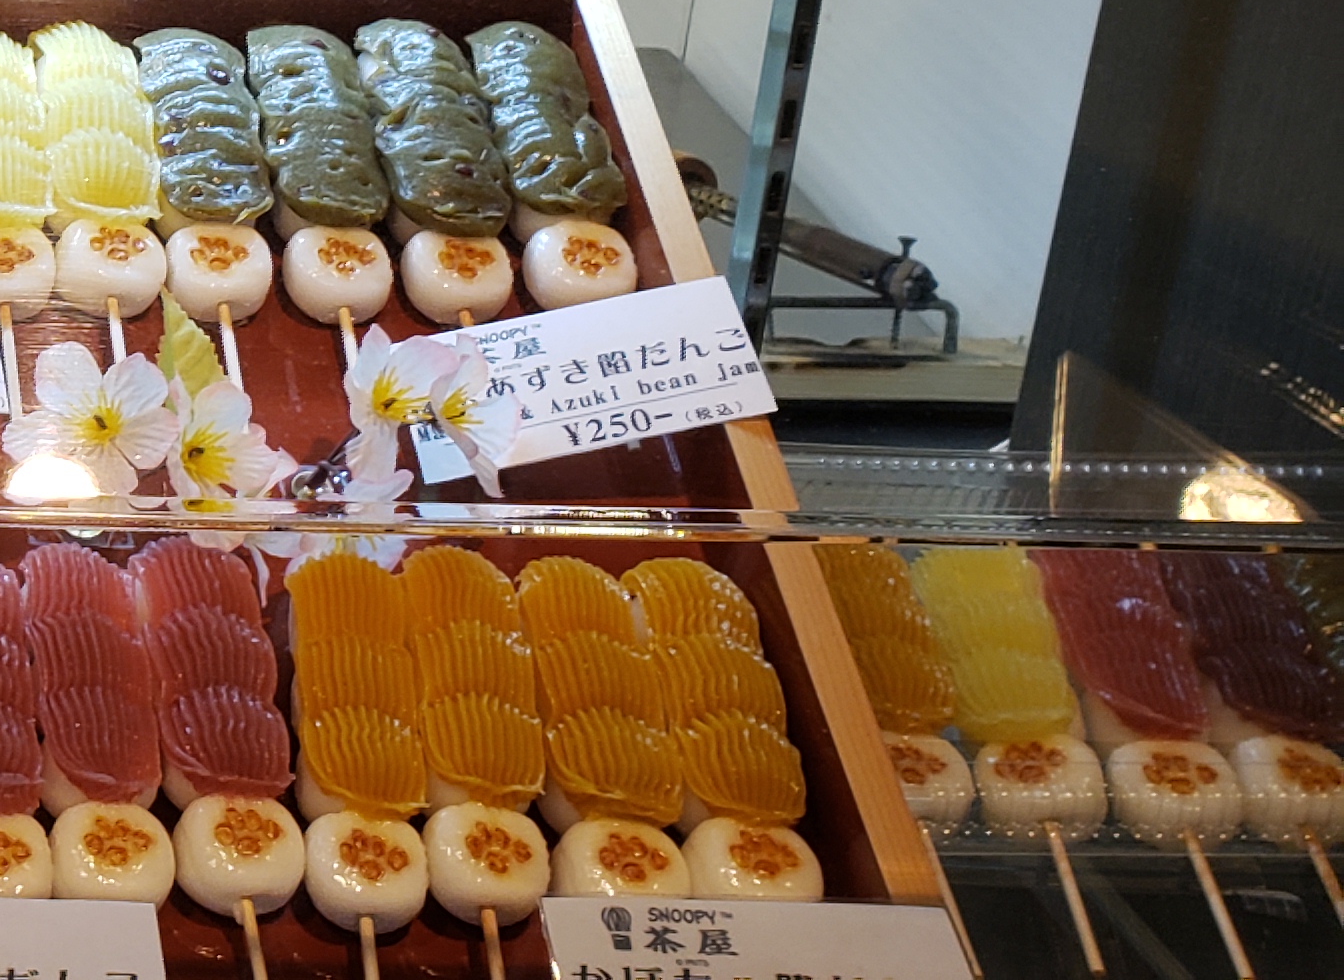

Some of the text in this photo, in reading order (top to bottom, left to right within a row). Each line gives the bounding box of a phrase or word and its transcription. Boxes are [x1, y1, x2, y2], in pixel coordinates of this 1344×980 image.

[520, 405, 534, 419] &
[550, 384, 622, 414] Azuki
[638, 371, 697, 395] bean
[561, 408, 673, 446] ¥250-
[647, 907, 716, 925] SNOOPY
[644, 927, 739, 956] 茶屋
